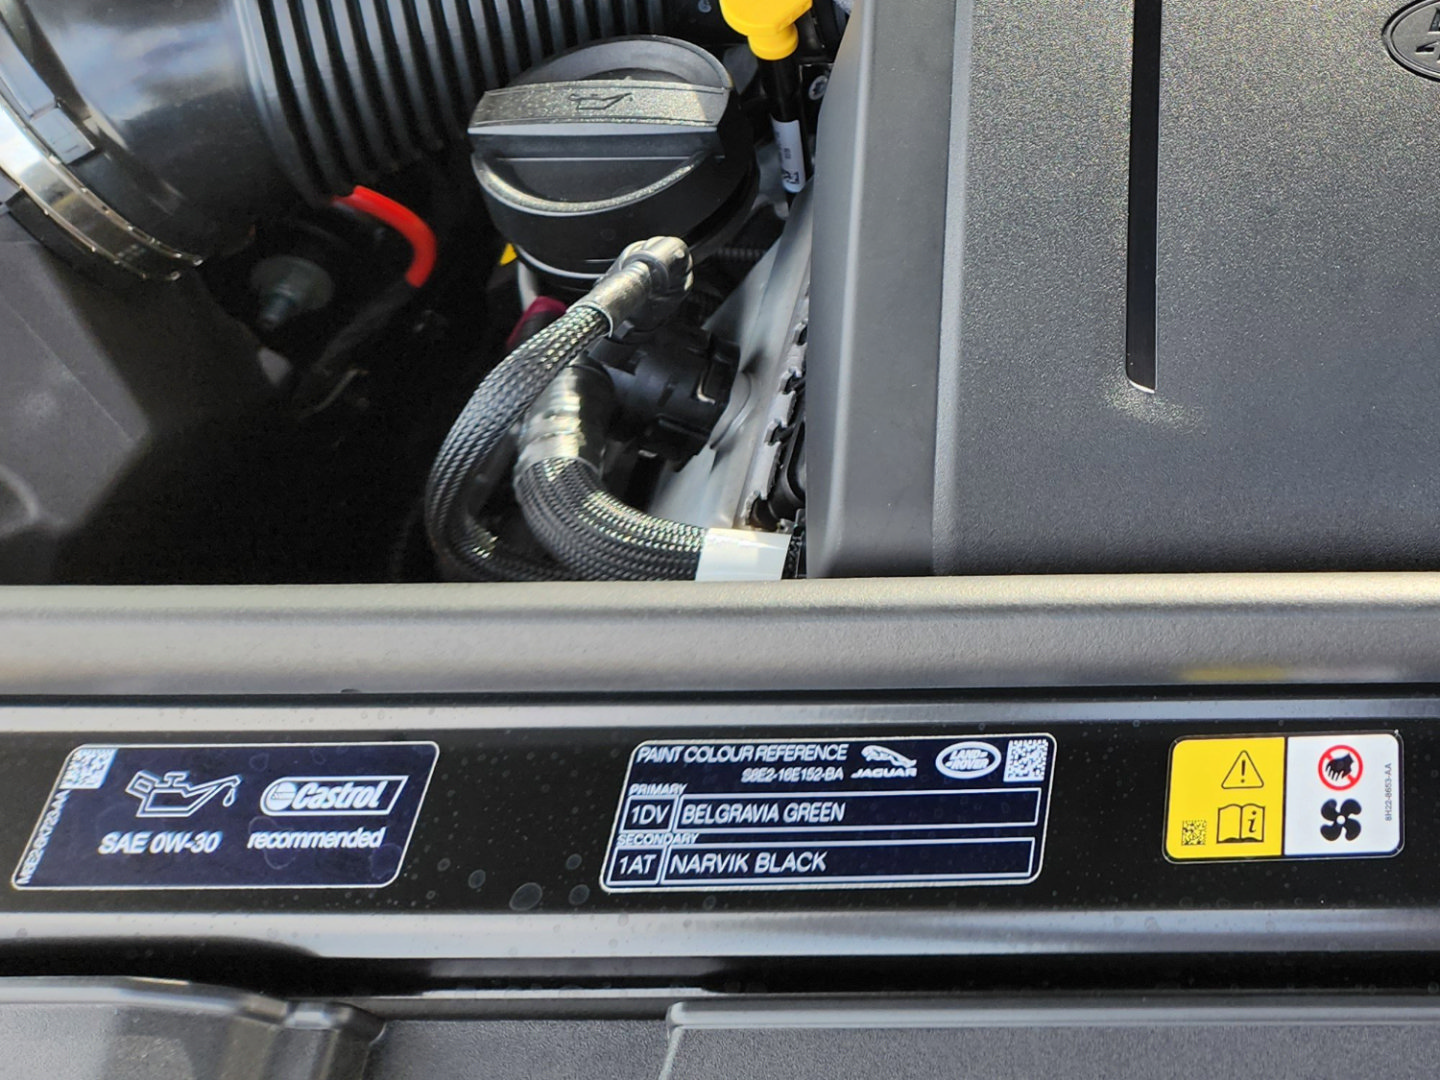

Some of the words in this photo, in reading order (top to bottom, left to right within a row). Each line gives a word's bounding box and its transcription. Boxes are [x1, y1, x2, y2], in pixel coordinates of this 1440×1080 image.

[636, 745, 685, 764] PAINT
[683, 745, 753, 763] COLOUR
[754, 744, 849, 762] REFERENCE
[949, 749, 982, 760] LAND
[850, 767, 917, 779] JAGUAR
[951, 759, 989, 771] ROVER
[291, 780, 389, 810] Castrol
[628, 783, 688, 796] PRIMARY
[631, 804, 671, 825] 1DV
[681, 803, 780, 824] BELGRAVIA
[783, 802, 847, 823] GREEN
[98, 830, 153, 854] SAE
[149, 830, 223, 854] 0W-30
[247, 826, 387, 849] recommended
[616, 832, 700, 846] SECONDARY
[619, 854, 657, 874] 1AT
[669, 853, 751, 874] NARVIK
[754, 851, 828, 873] BLACK
